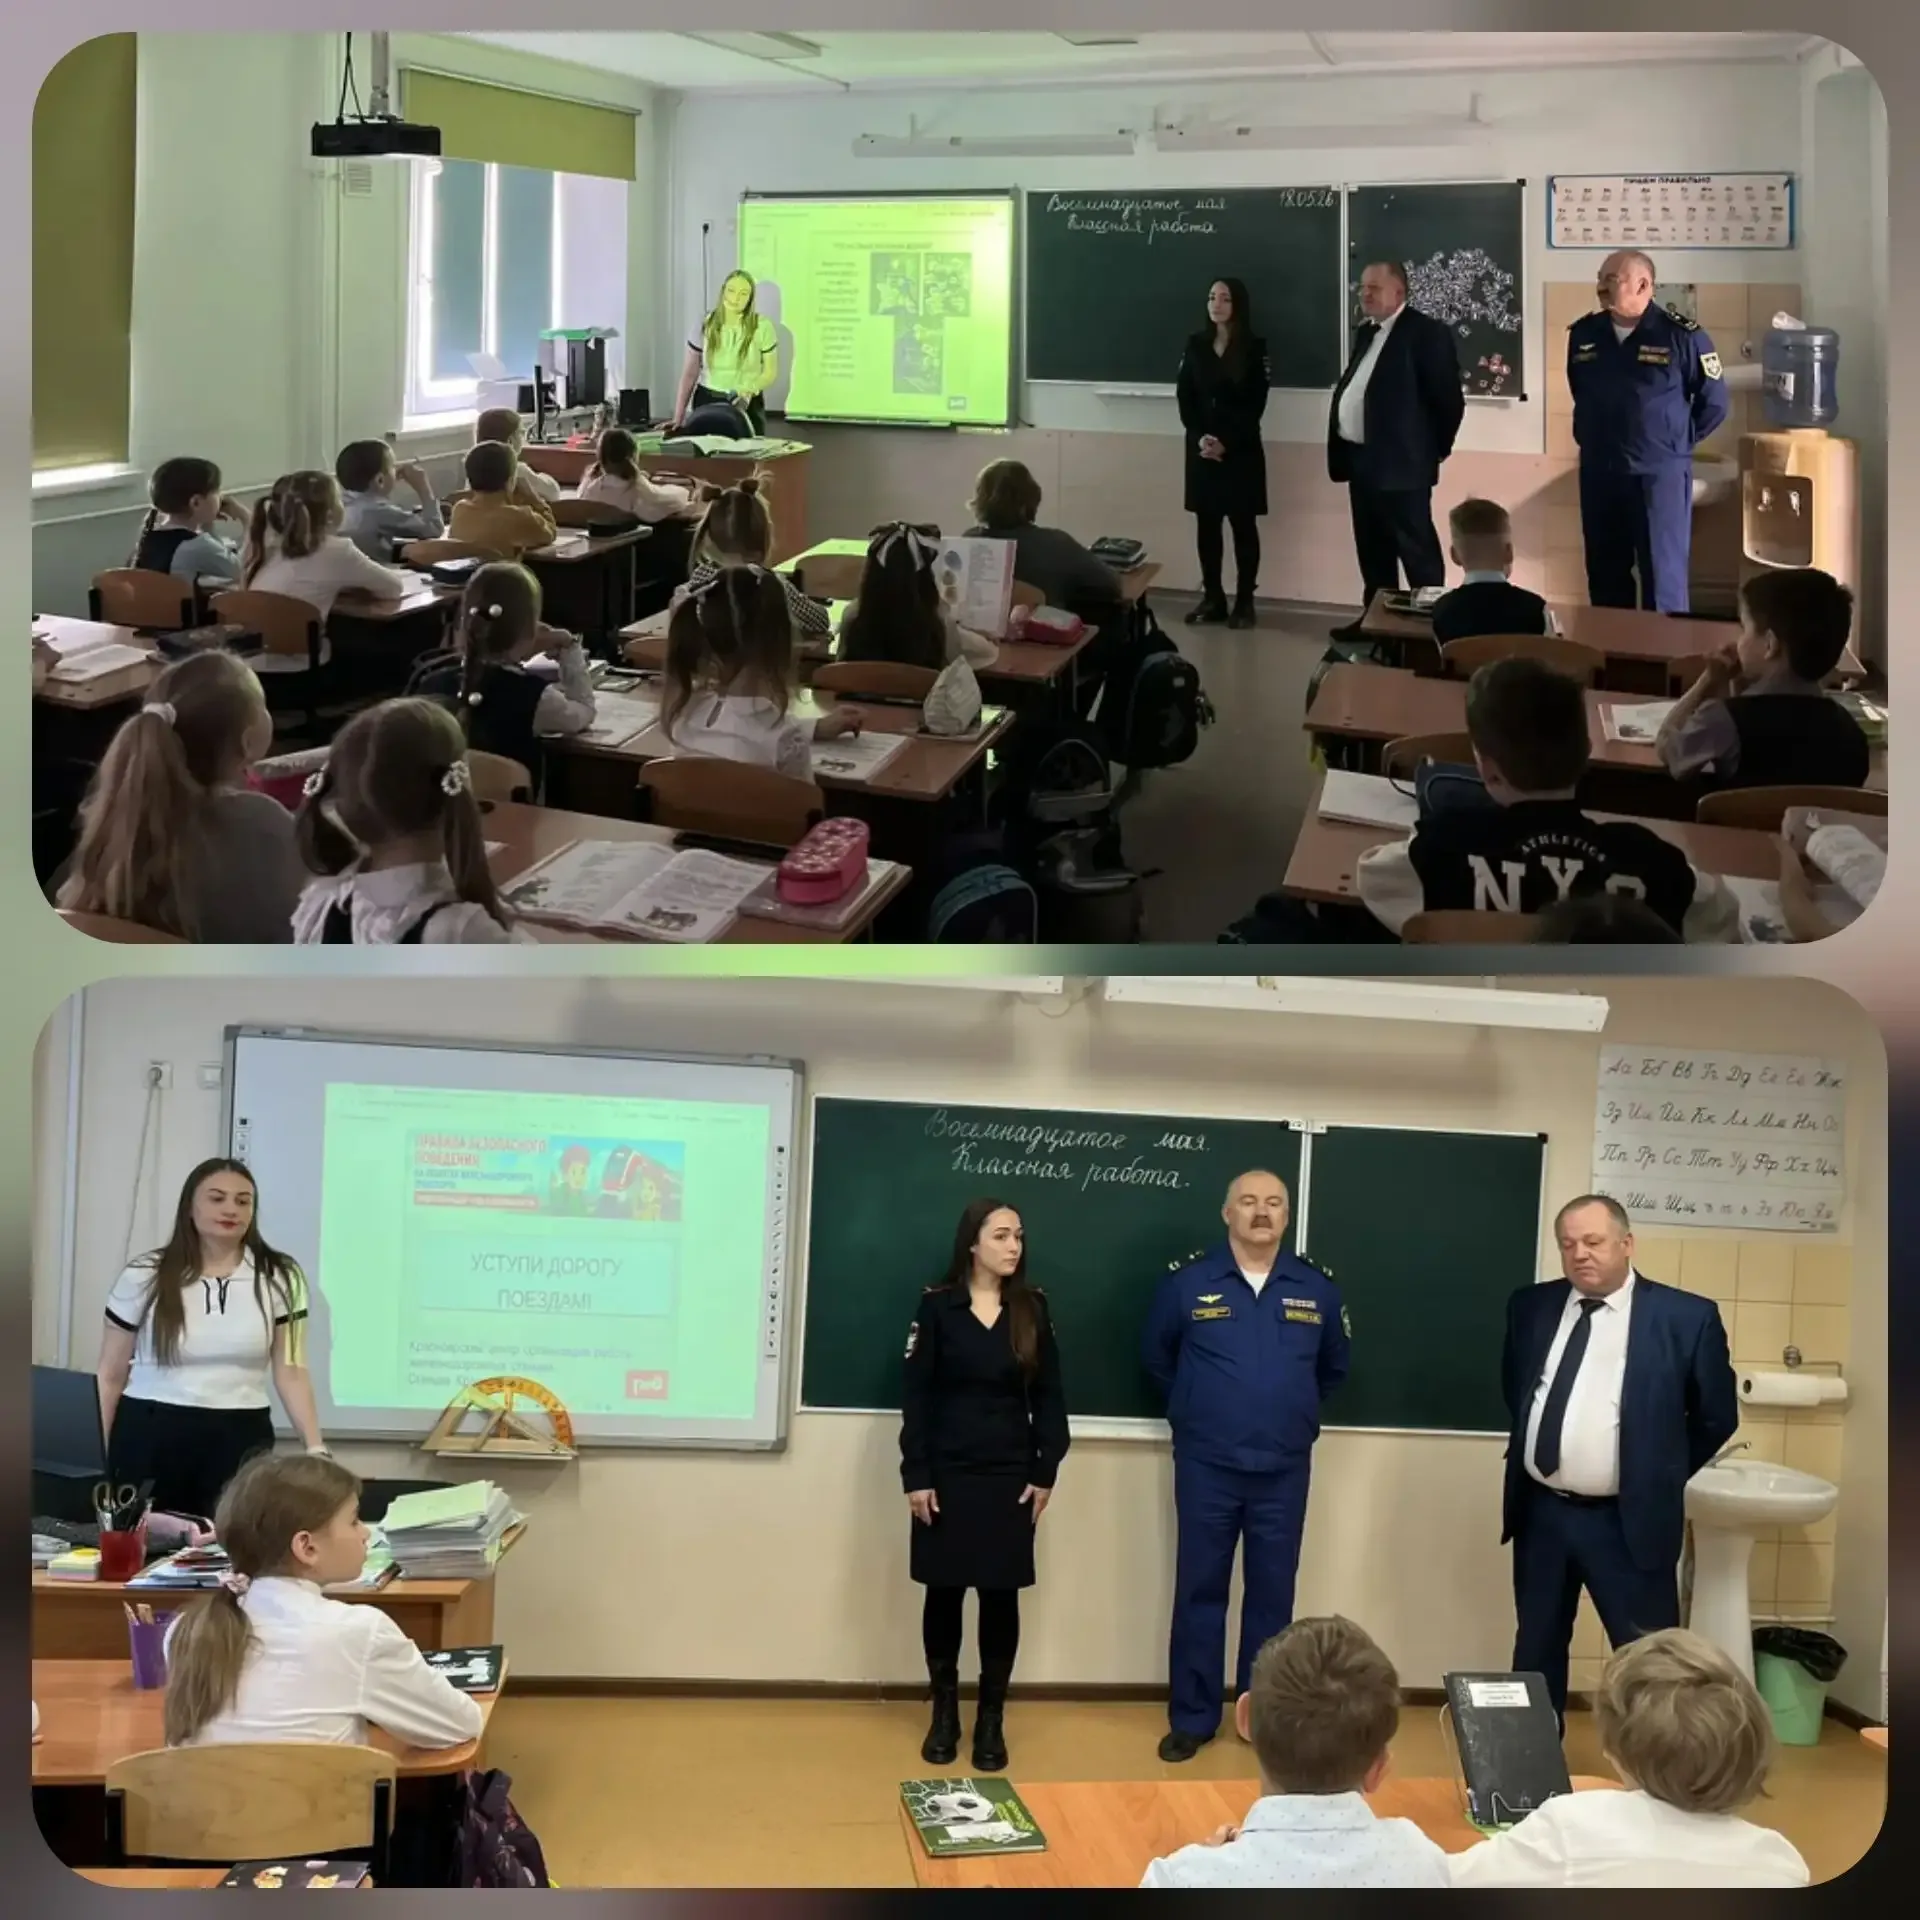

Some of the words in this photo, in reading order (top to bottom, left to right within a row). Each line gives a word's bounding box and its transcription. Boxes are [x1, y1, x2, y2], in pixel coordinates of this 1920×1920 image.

[1148, 210, 1217, 245] работа
[1521, 833, 1606, 863] ATHLETICS
[1604, 1057, 1632, 1075] Аа
[1640, 1058, 1668, 1076] Бб
[1672, 1060, 1693, 1078] Вв
[1726, 1065, 1751, 1088] Дд
[924, 1108, 1128, 1154] Восемнадцатое
[1690, 1106, 1716, 1125] Кк
[1722, 1109, 1749, 1127] Лл
[1753, 1111, 1786, 1129] Мм
[1792, 1112, 1819, 1131] Нн
[951, 1141, 1075, 1179] Классная
[1599, 1143, 1628, 1162] Пп
[1634, 1145, 1656, 1170] Рр
[1662, 1147, 1682, 1166] Сс
[1686, 1148, 1724, 1168] Тт
[1729, 1150, 1748, 1176] Уу
[1626, 1191, 1657, 1210] Шш
[1664, 1193, 1696, 1215] Щщ
[471, 1253, 543, 1273] УСТУПИ
[547, 1257, 623, 1279] ДОРОГУ
